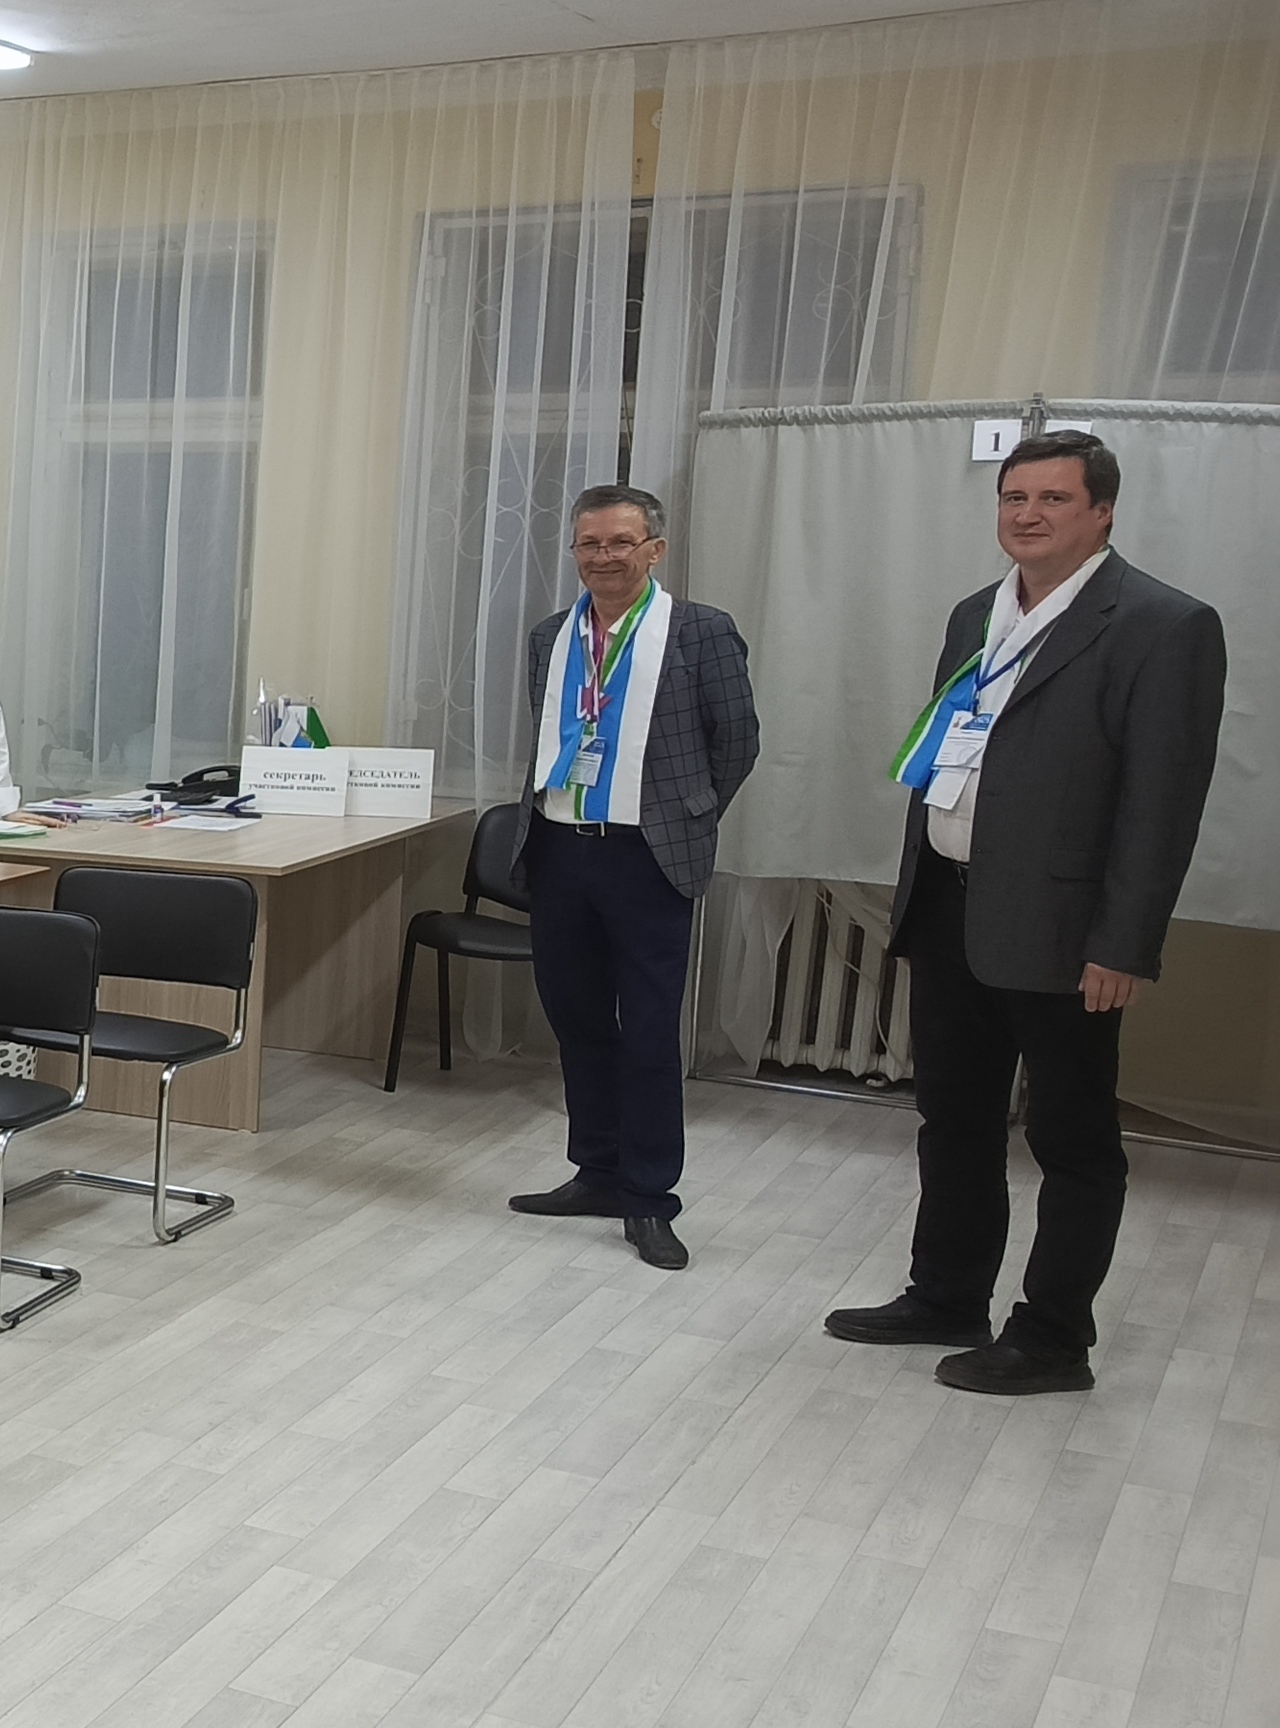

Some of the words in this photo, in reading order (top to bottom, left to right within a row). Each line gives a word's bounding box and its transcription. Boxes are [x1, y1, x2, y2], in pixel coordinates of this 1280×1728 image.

[989, 429, 1002, 452] 1
[263, 770, 327, 782] секретарь
[348, 769, 421, 780] ЕДСЕДАТЕЛЬ
